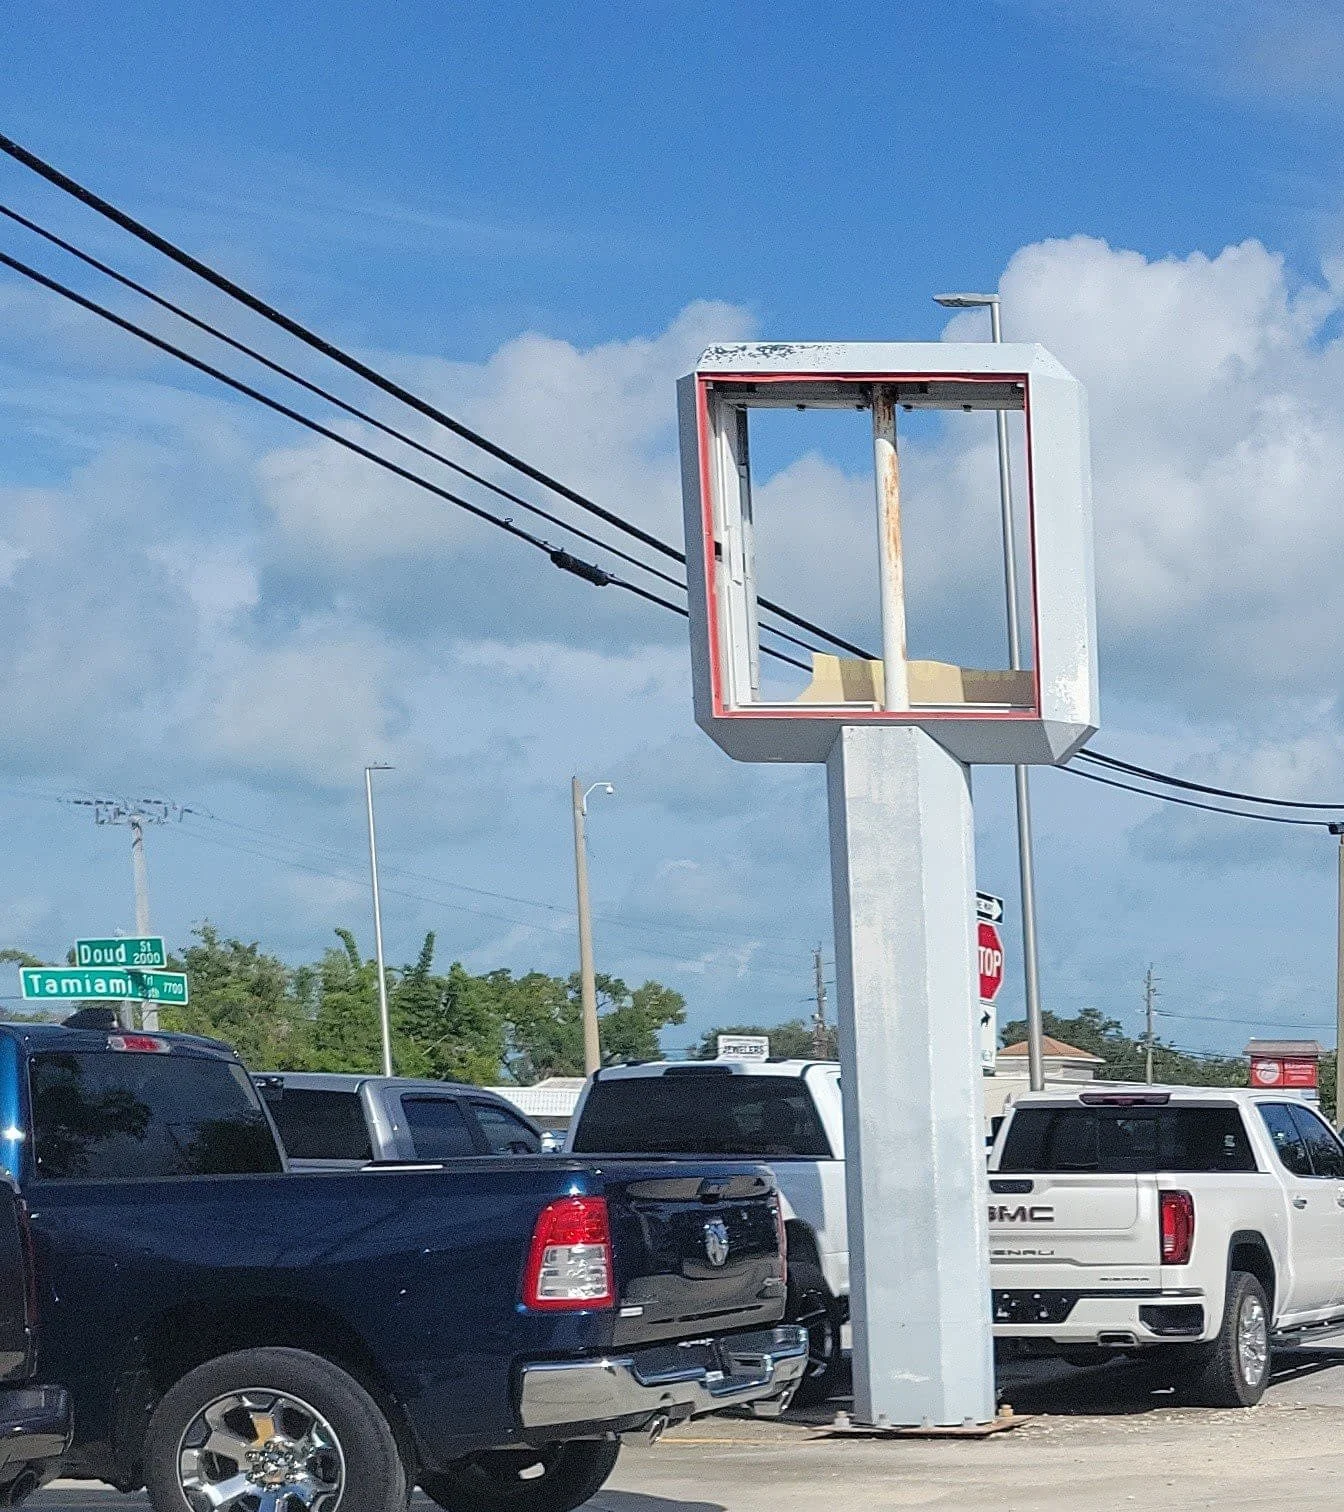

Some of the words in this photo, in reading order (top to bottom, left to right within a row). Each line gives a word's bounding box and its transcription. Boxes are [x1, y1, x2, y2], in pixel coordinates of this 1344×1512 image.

[80, 944, 127, 964] Doud
[140, 941, 151, 951] St
[133, 952, 161, 965] 2000
[979, 946, 1001, 978] TOP
[29, 974, 133, 995] Tamiami
[163, 982, 183, 994] 7700
